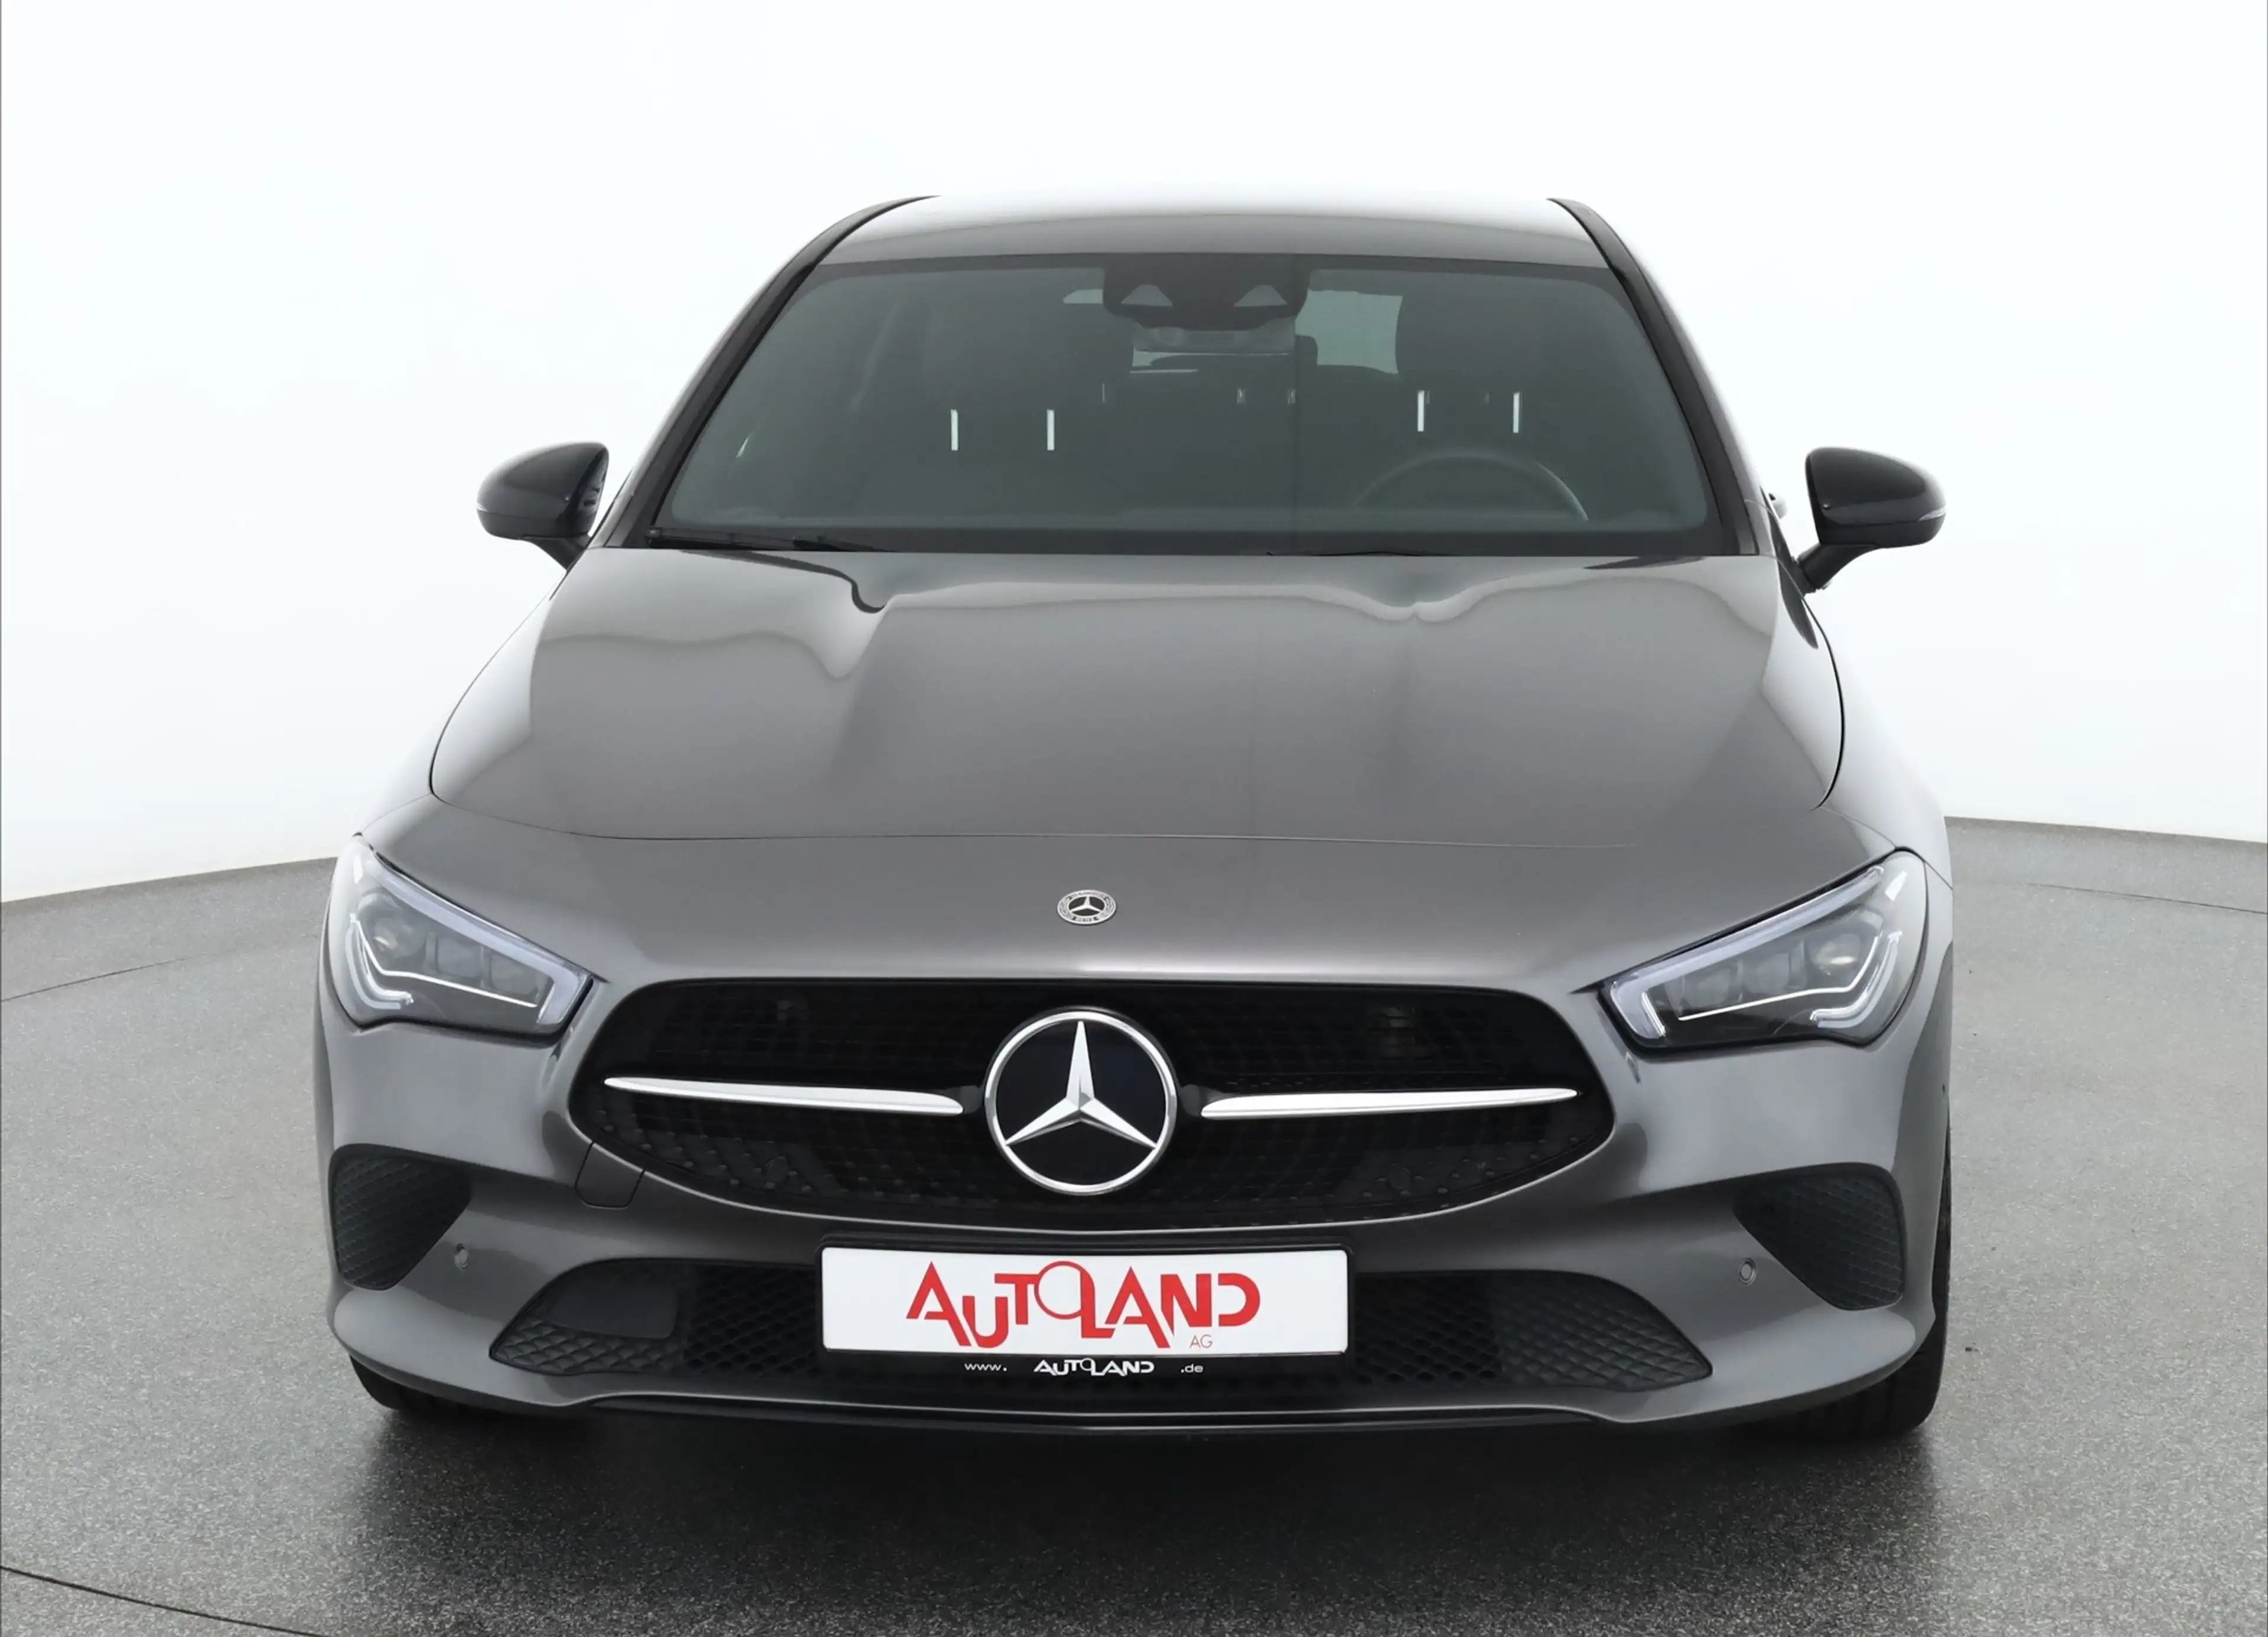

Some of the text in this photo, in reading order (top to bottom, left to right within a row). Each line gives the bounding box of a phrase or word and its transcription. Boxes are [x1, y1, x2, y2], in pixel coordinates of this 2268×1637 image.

[1189, 1333, 1213, 1349] AG
[964, 1363, 1007, 1372] www.
[1180, 1363, 1204, 1373] .de
